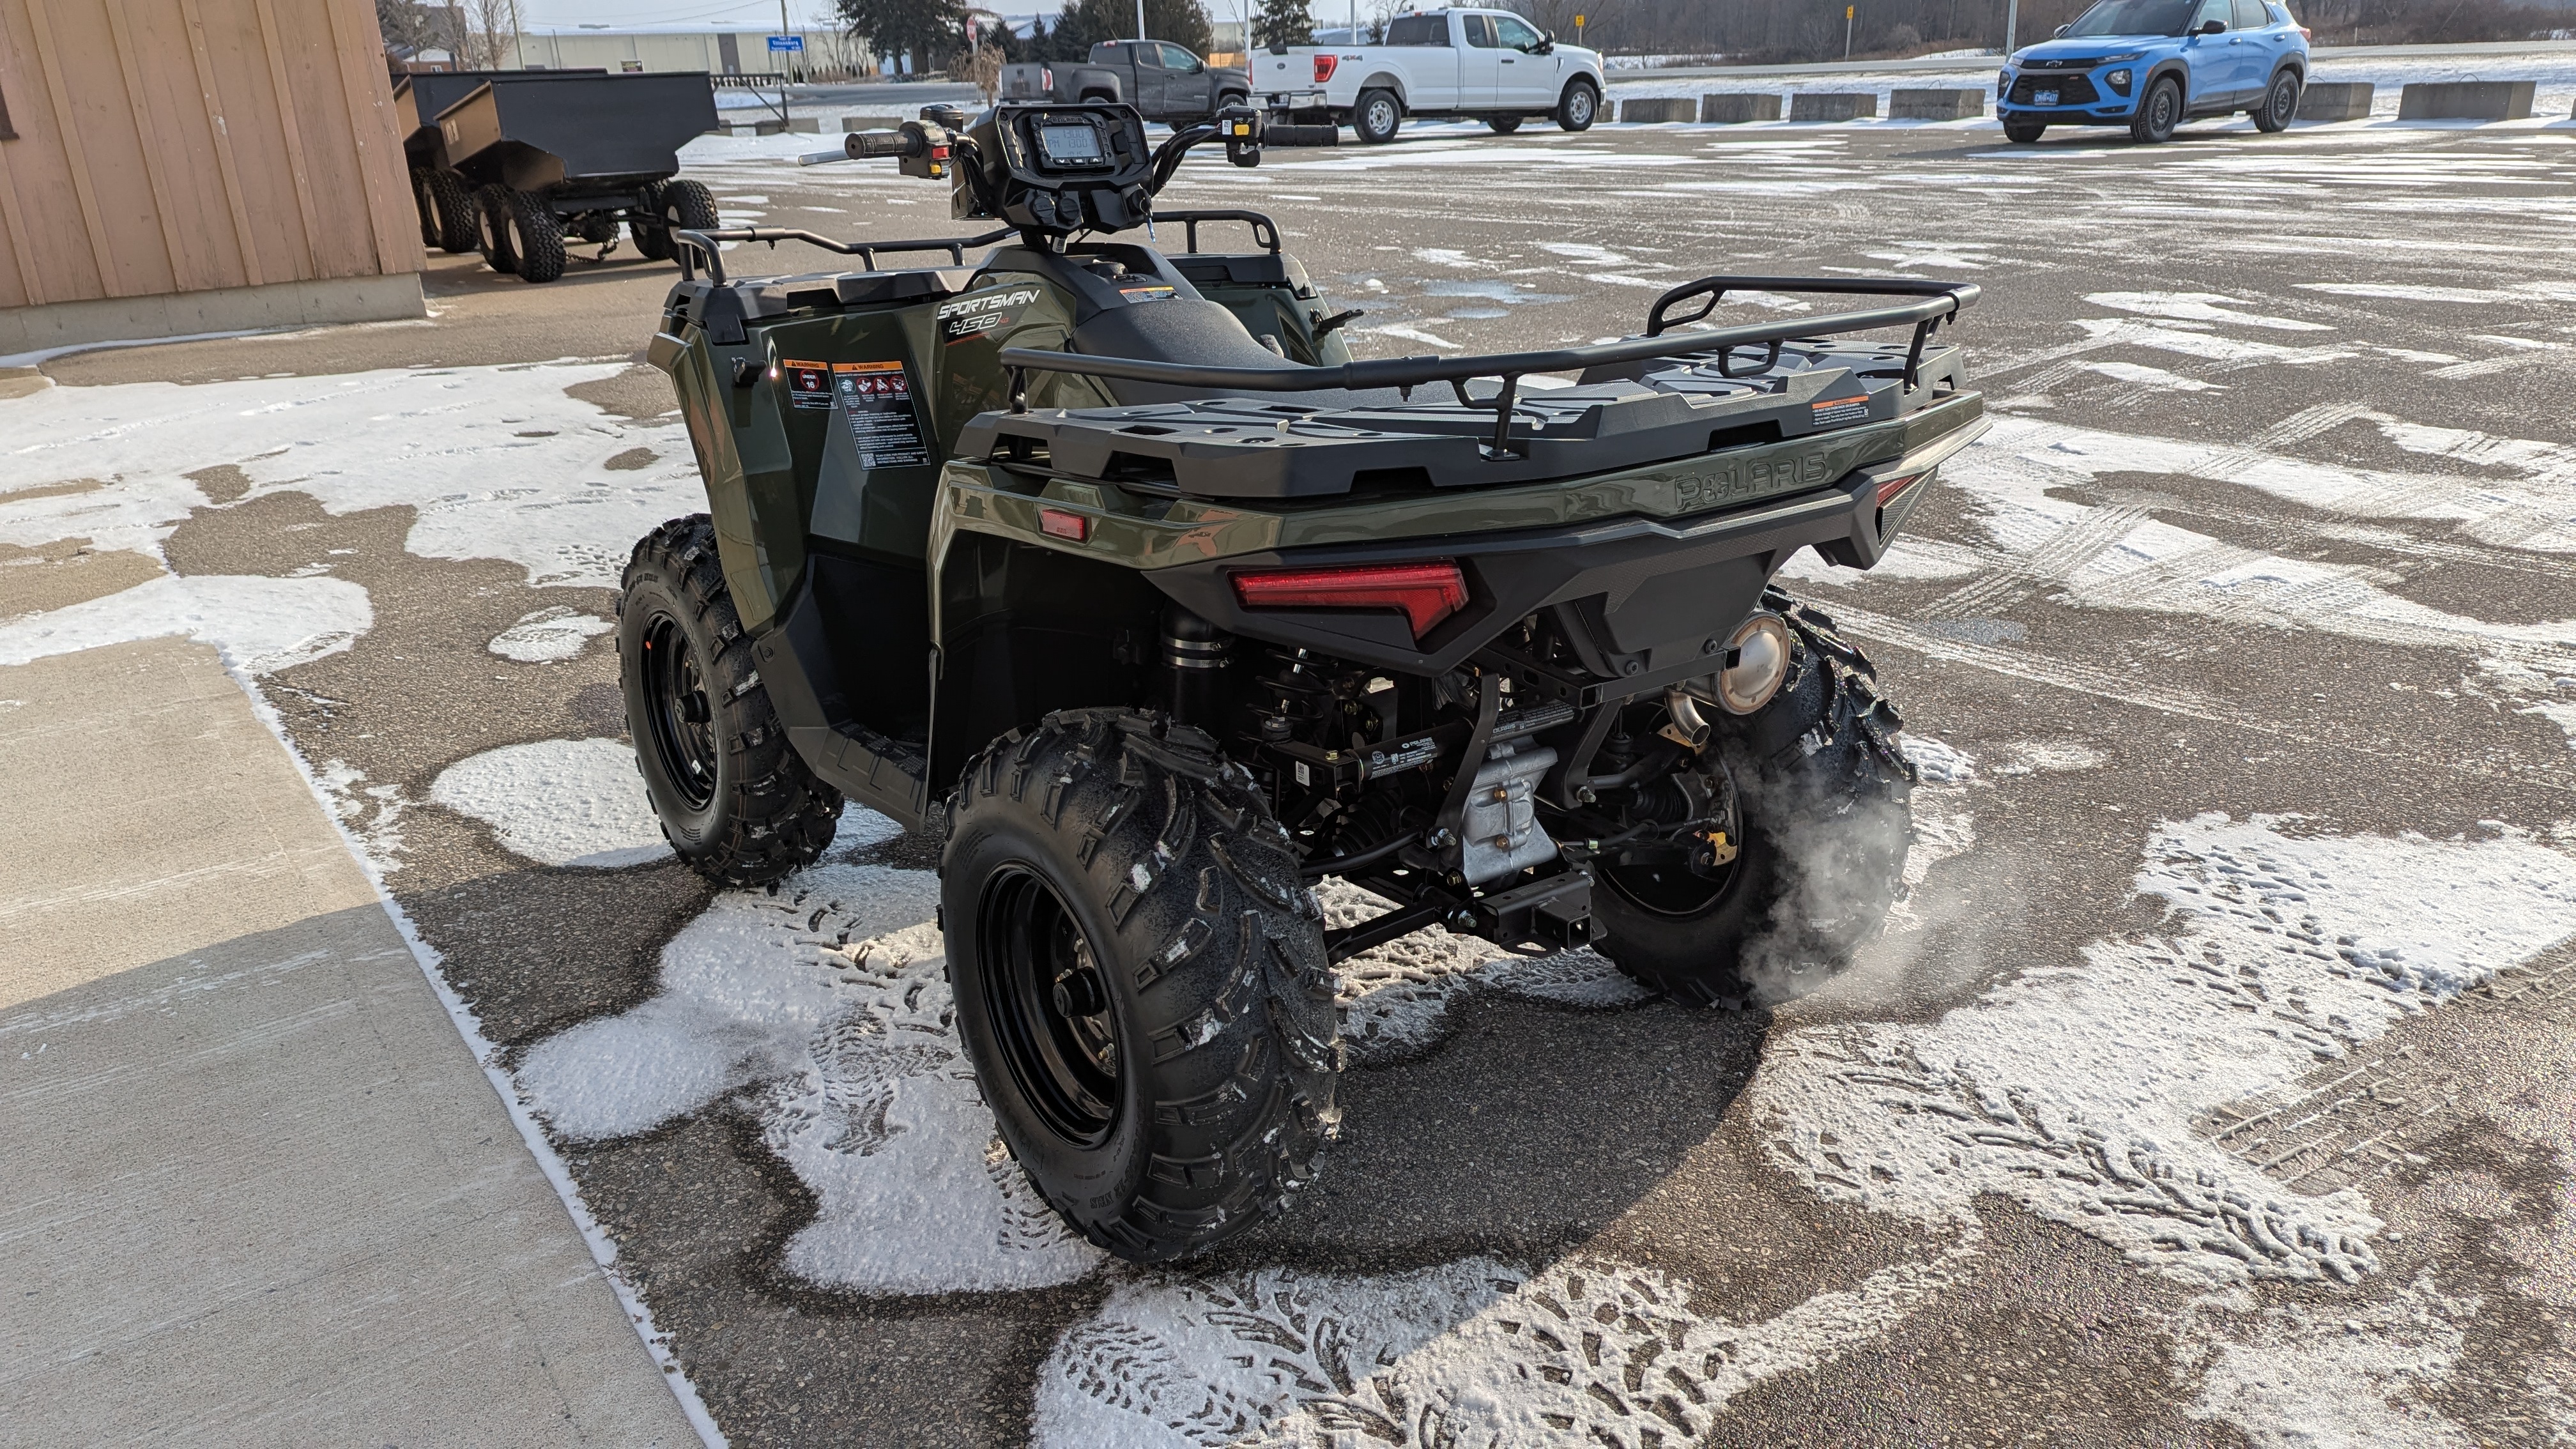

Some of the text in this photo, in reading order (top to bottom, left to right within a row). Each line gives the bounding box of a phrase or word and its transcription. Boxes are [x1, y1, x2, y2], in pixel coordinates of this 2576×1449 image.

[937, 289, 1041, 320] SPORTSMAN
[949, 312, 1003, 335] 450
[1675, 452, 1826, 509] POLARIS
[1492, 723, 1516, 733] OLARIS
[1409, 737, 1433, 746] POLARIS
